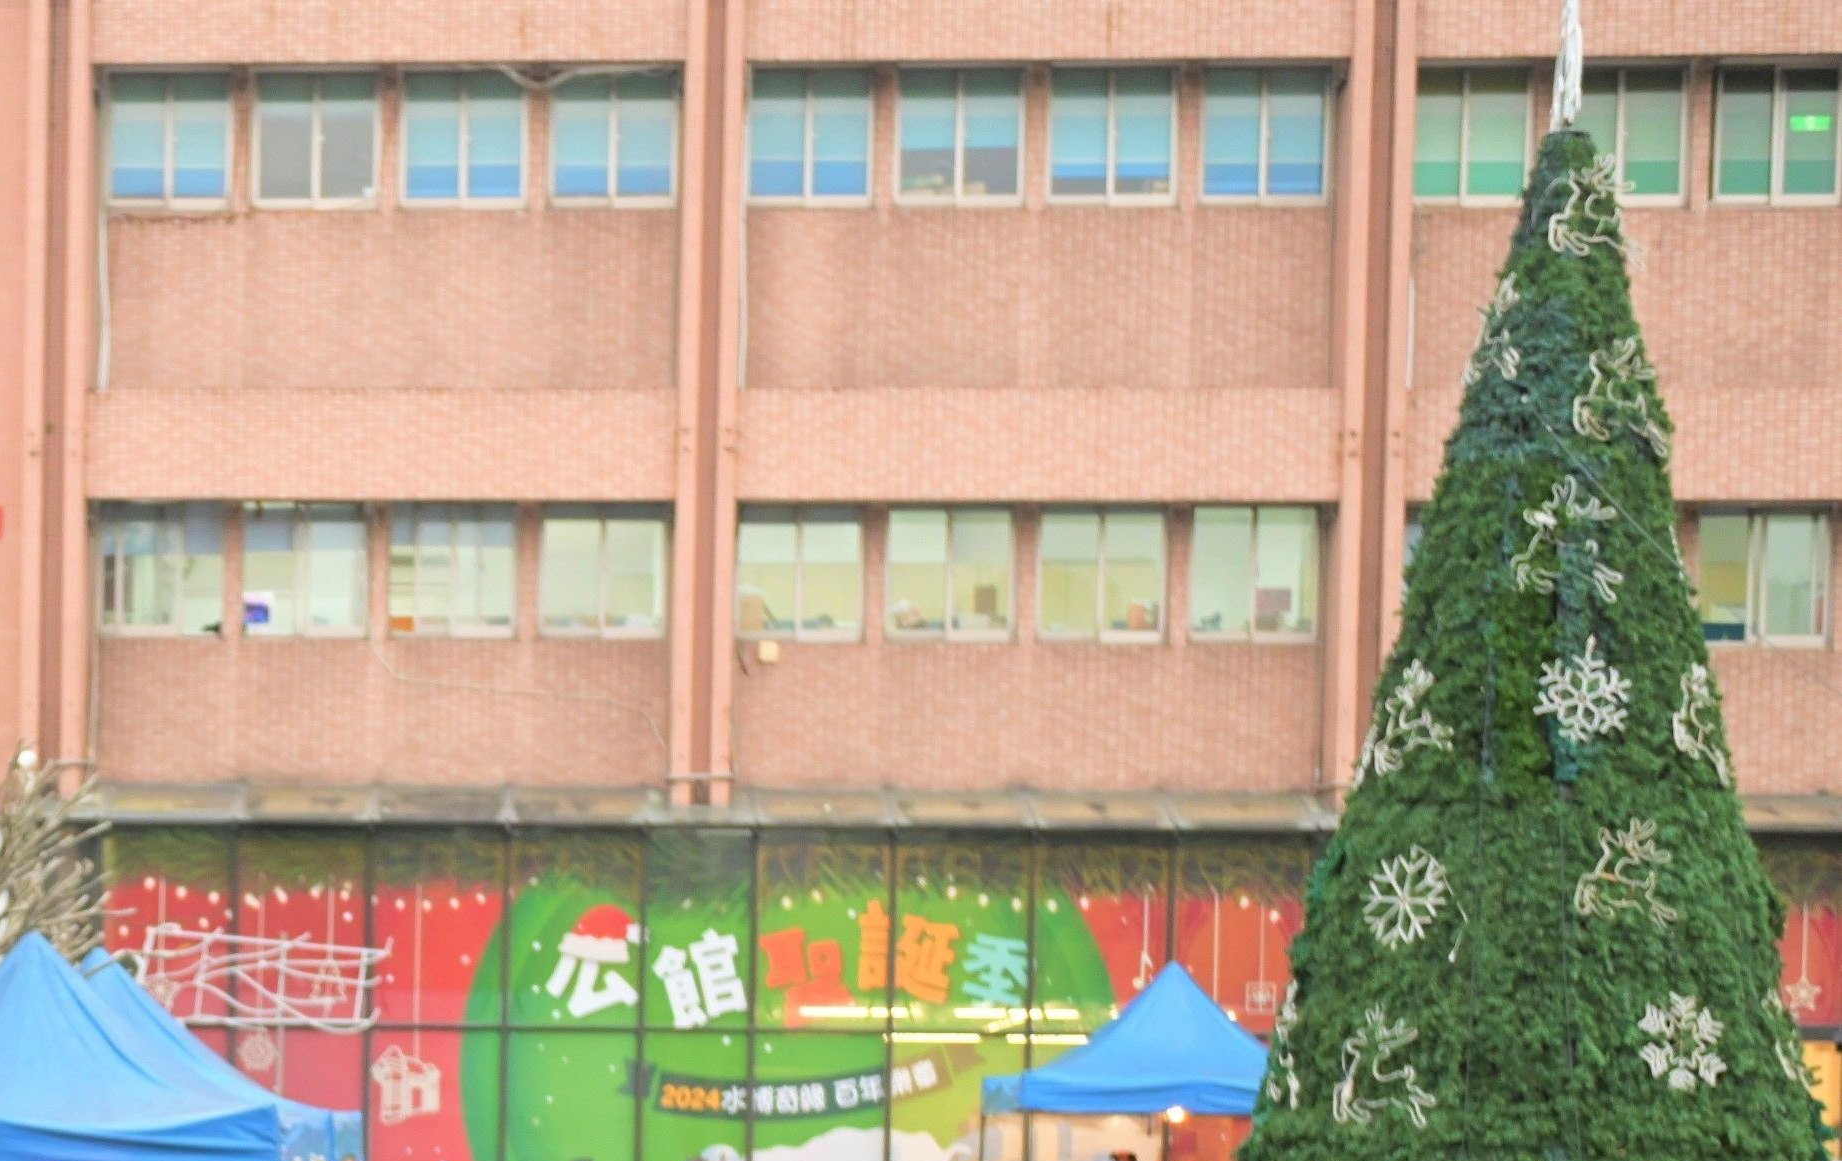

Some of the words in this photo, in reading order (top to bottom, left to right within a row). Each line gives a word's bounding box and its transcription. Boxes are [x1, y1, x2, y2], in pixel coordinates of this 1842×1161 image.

[544, 900, 1029, 1029] 公館聖誕季
